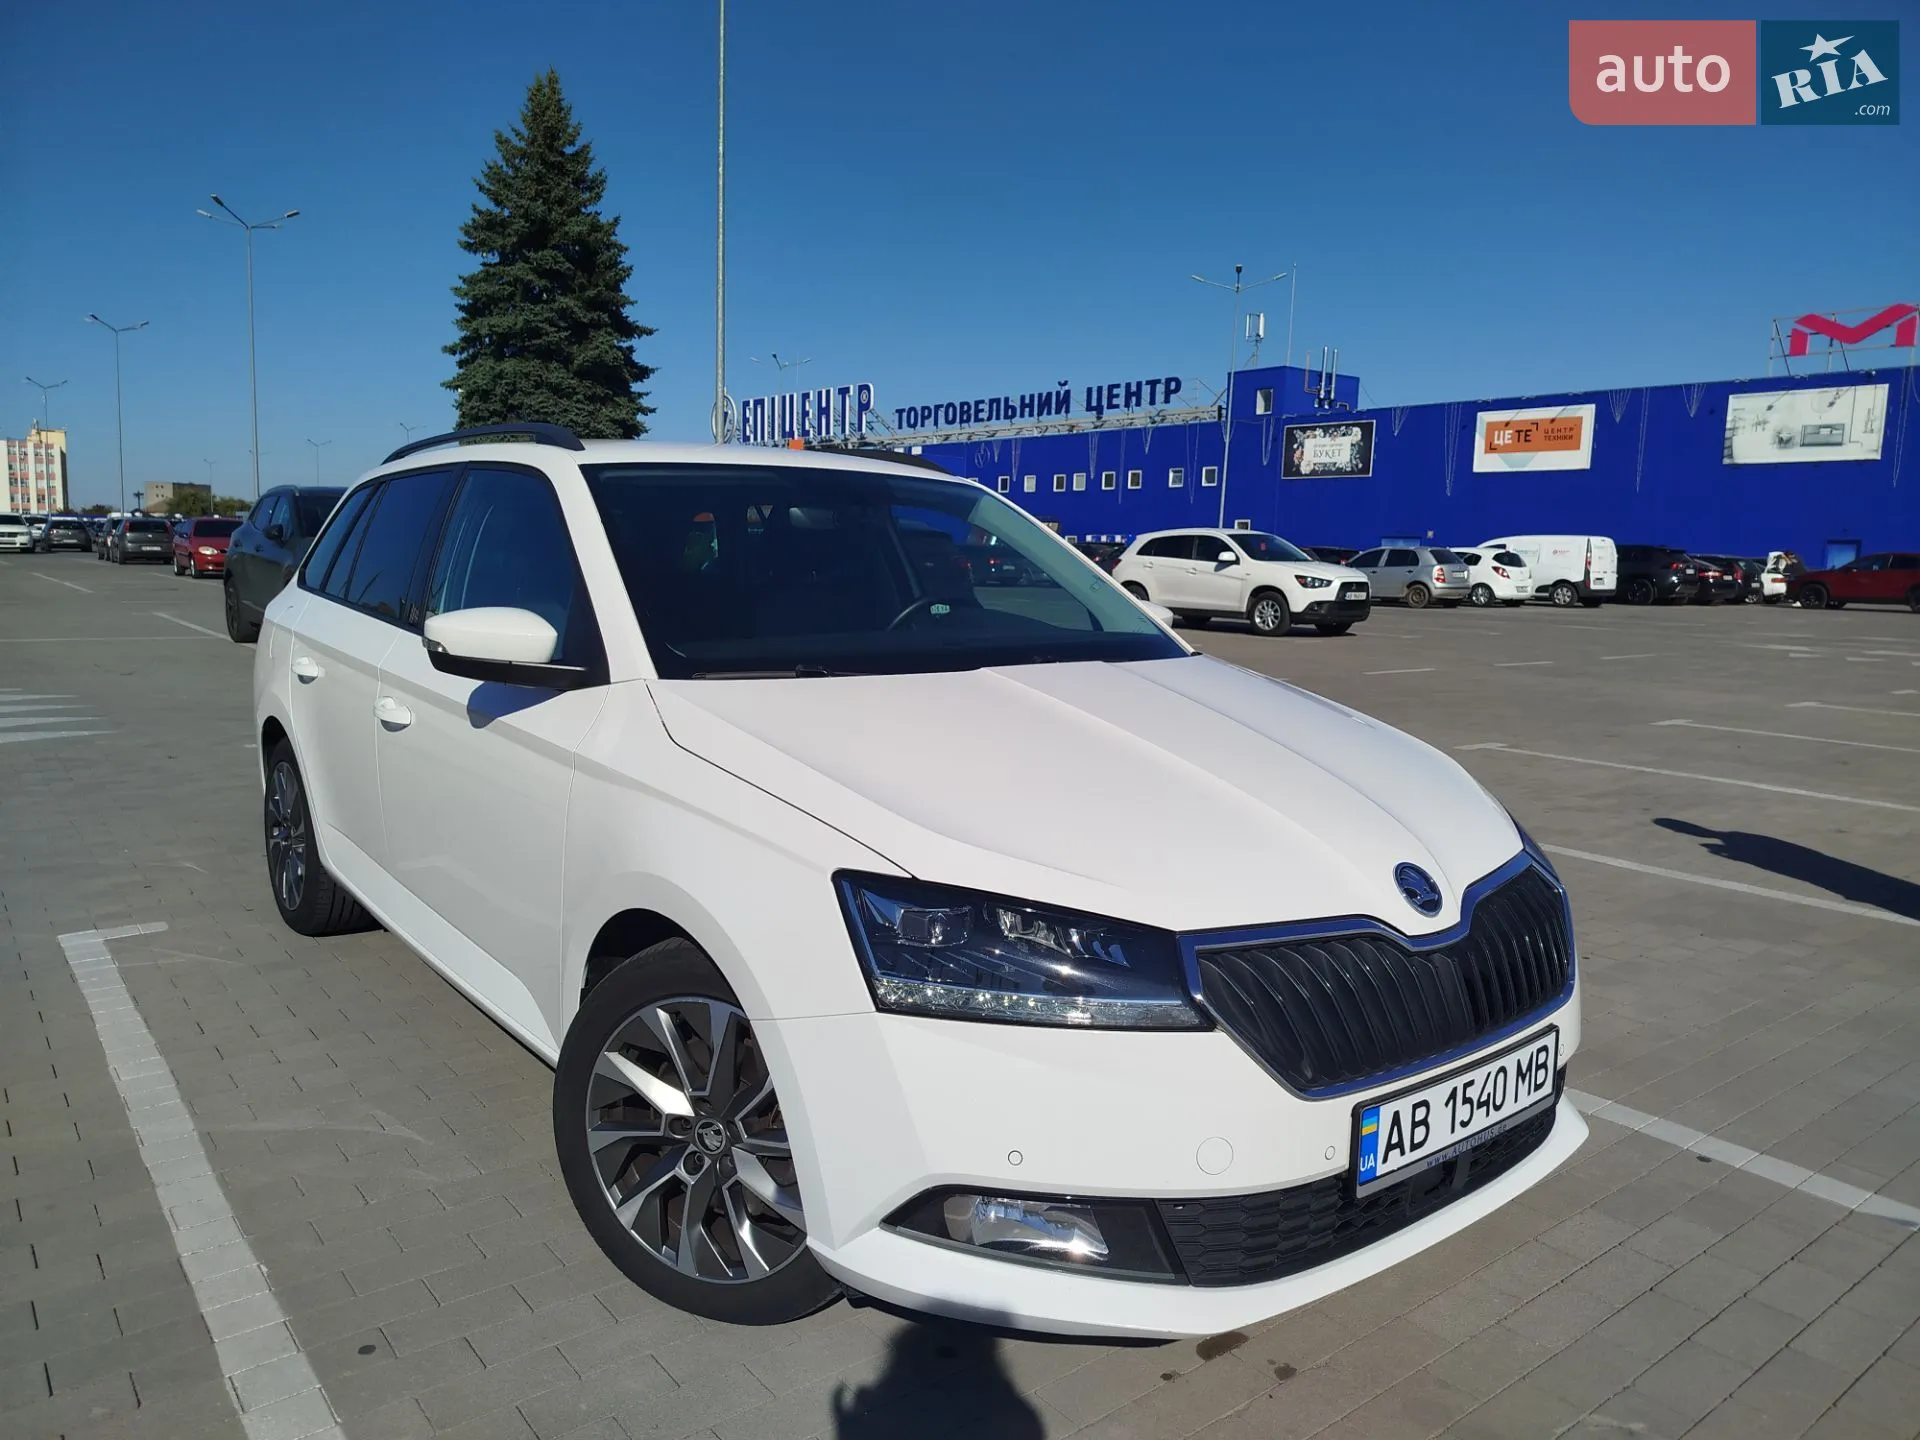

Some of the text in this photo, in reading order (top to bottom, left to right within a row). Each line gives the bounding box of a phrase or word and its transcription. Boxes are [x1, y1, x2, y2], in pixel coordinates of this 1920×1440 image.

[741, 382, 874, 444] ЕПІЦЕНТР
[895, 376, 1182, 430] ТОРГОВЕЛЬНИЙ ЦЕНТР
[1544, 427, 1575, 435] ЦЕНТР
[1381, 1044, 1550, 1165] AB 1540 MB
[1360, 1152, 1376, 1172] UA
